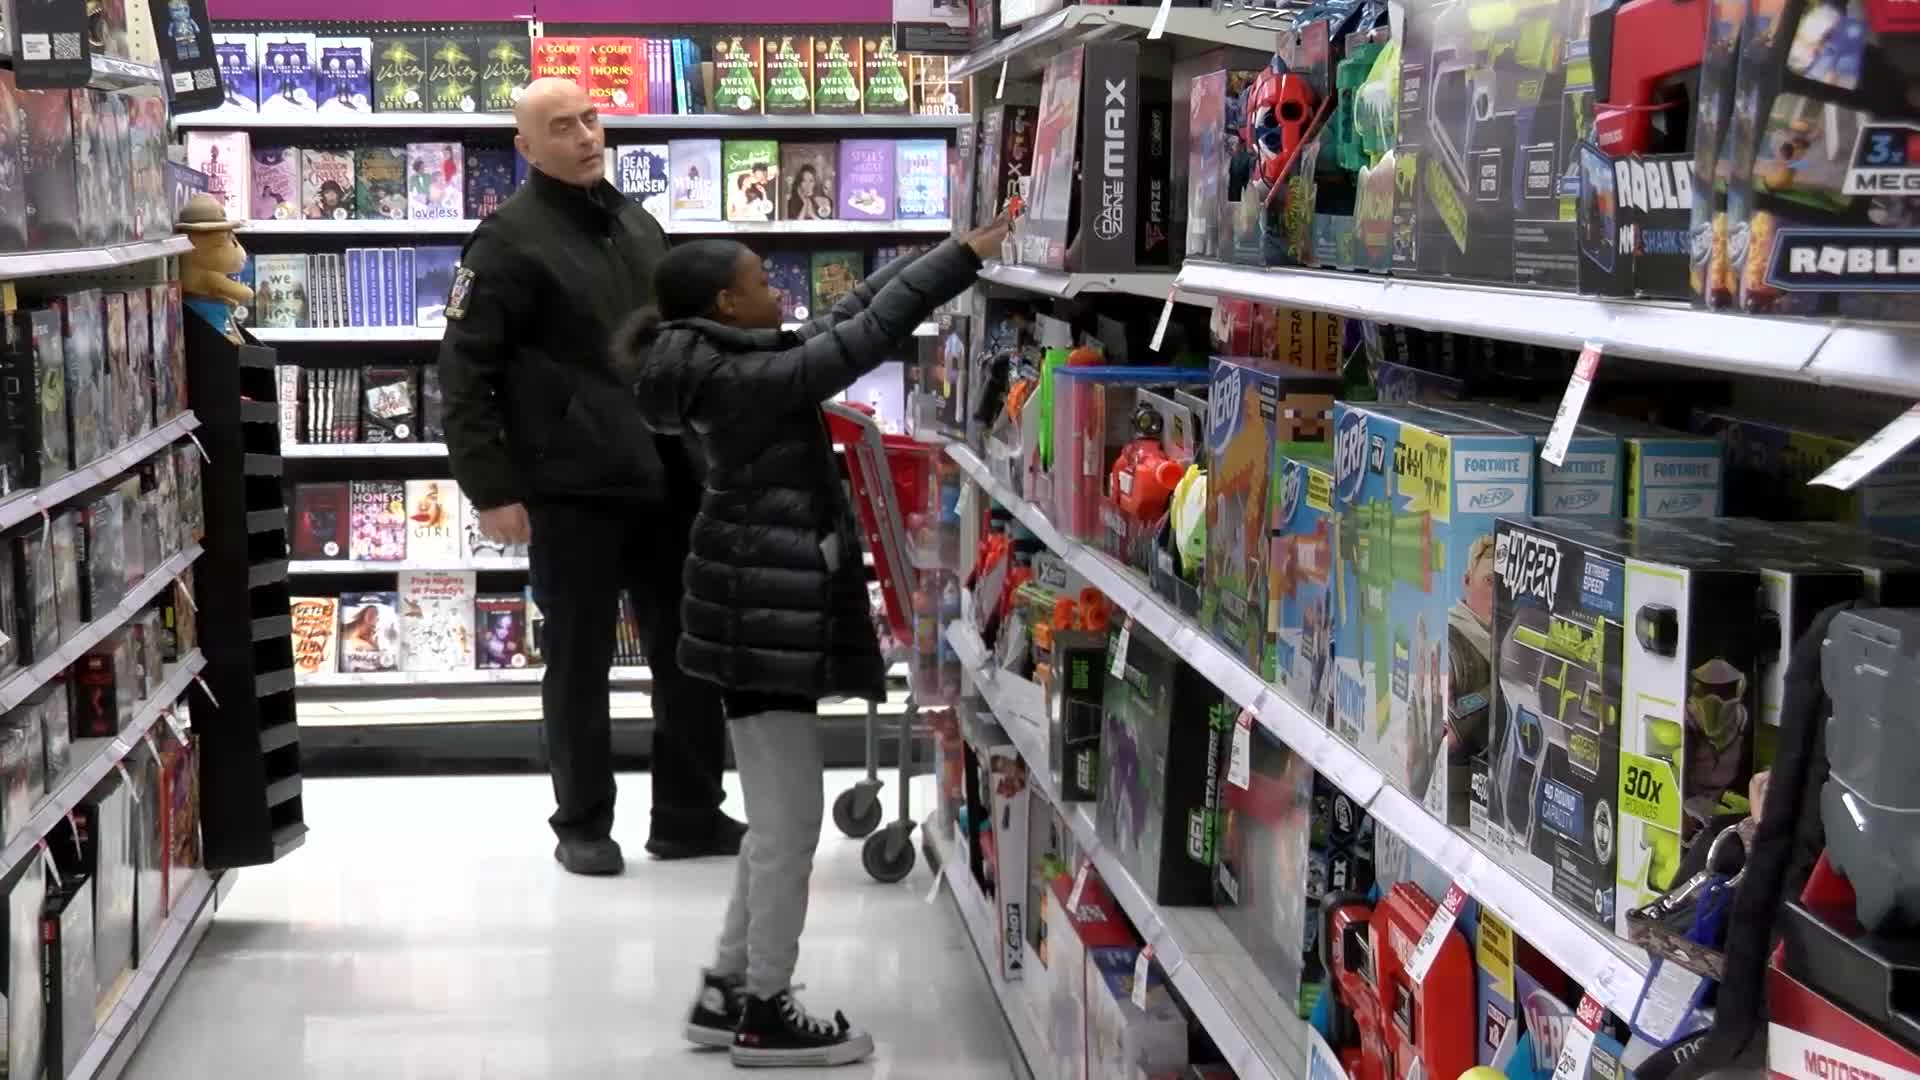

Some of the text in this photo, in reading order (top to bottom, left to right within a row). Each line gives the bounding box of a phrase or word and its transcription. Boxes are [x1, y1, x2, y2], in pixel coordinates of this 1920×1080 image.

[537, 45, 581, 54] A COURT
[590, 45, 633, 54] A COURT
[483, 62, 530, 81] Verity
[537, 65, 582, 76] THORNS
[589, 65, 633, 76] THORNS
[716, 61, 759, 69] HUSBANDS
[767, 61, 809, 69] HUSBANDS
[816, 61, 858, 69] HUSBANDS
[377, 64, 427, 82] Verity
[429, 64, 480, 82] Verity
[613, 77, 629, 85] AND
[720, 78, 755, 86] EVELYN
[770, 78, 803, 86] EVELYN
[820, 77, 853, 86] EVELYN
[869, 77, 902, 85] EVELYN
[724, 87, 752, 96] HUGO
[873, 86, 894, 95] HUG
[920, 103, 960, 116] HOOVER
[1103, 79, 1126, 178] MAX
[622, 156, 651, 169] DEAR
[622, 169, 651, 181] EVAN
[622, 180, 666, 194] HANSEN
[1615, 160, 1697, 214] ROBLO
[1103, 180, 1113, 234] DART
[1112, 180, 1124, 234] ZONE
[1151, 180, 1161, 223] FAZE
[412, 207, 459, 219] loveless
[1789, 245, 1920, 276] ROBLO
[1207, 366, 1241, 435] NERF
[1335, 414, 1369, 487] NERF
[1463, 457, 1521, 474] FORTNITE
[1654, 463, 1713, 478] FORTNITE
[353, 483, 377, 493] THE
[352, 493, 404, 503] HONEYS
[1468, 487, 1515, 508] NERF
[414, 527, 453, 538] GIRL
[1504, 529, 1561, 612] HYPER
[411, 576, 464, 586] Five Nights
[1583, 576, 1605, 596] SPEED
[423, 586, 465, 597] Freddy's
[1205, 728, 1220, 810] STARFIRE
[1624, 764, 1664, 805] 30x
[1543, 782, 1577, 813] 40 ROUND
[1188, 809, 1205, 860] GEL
